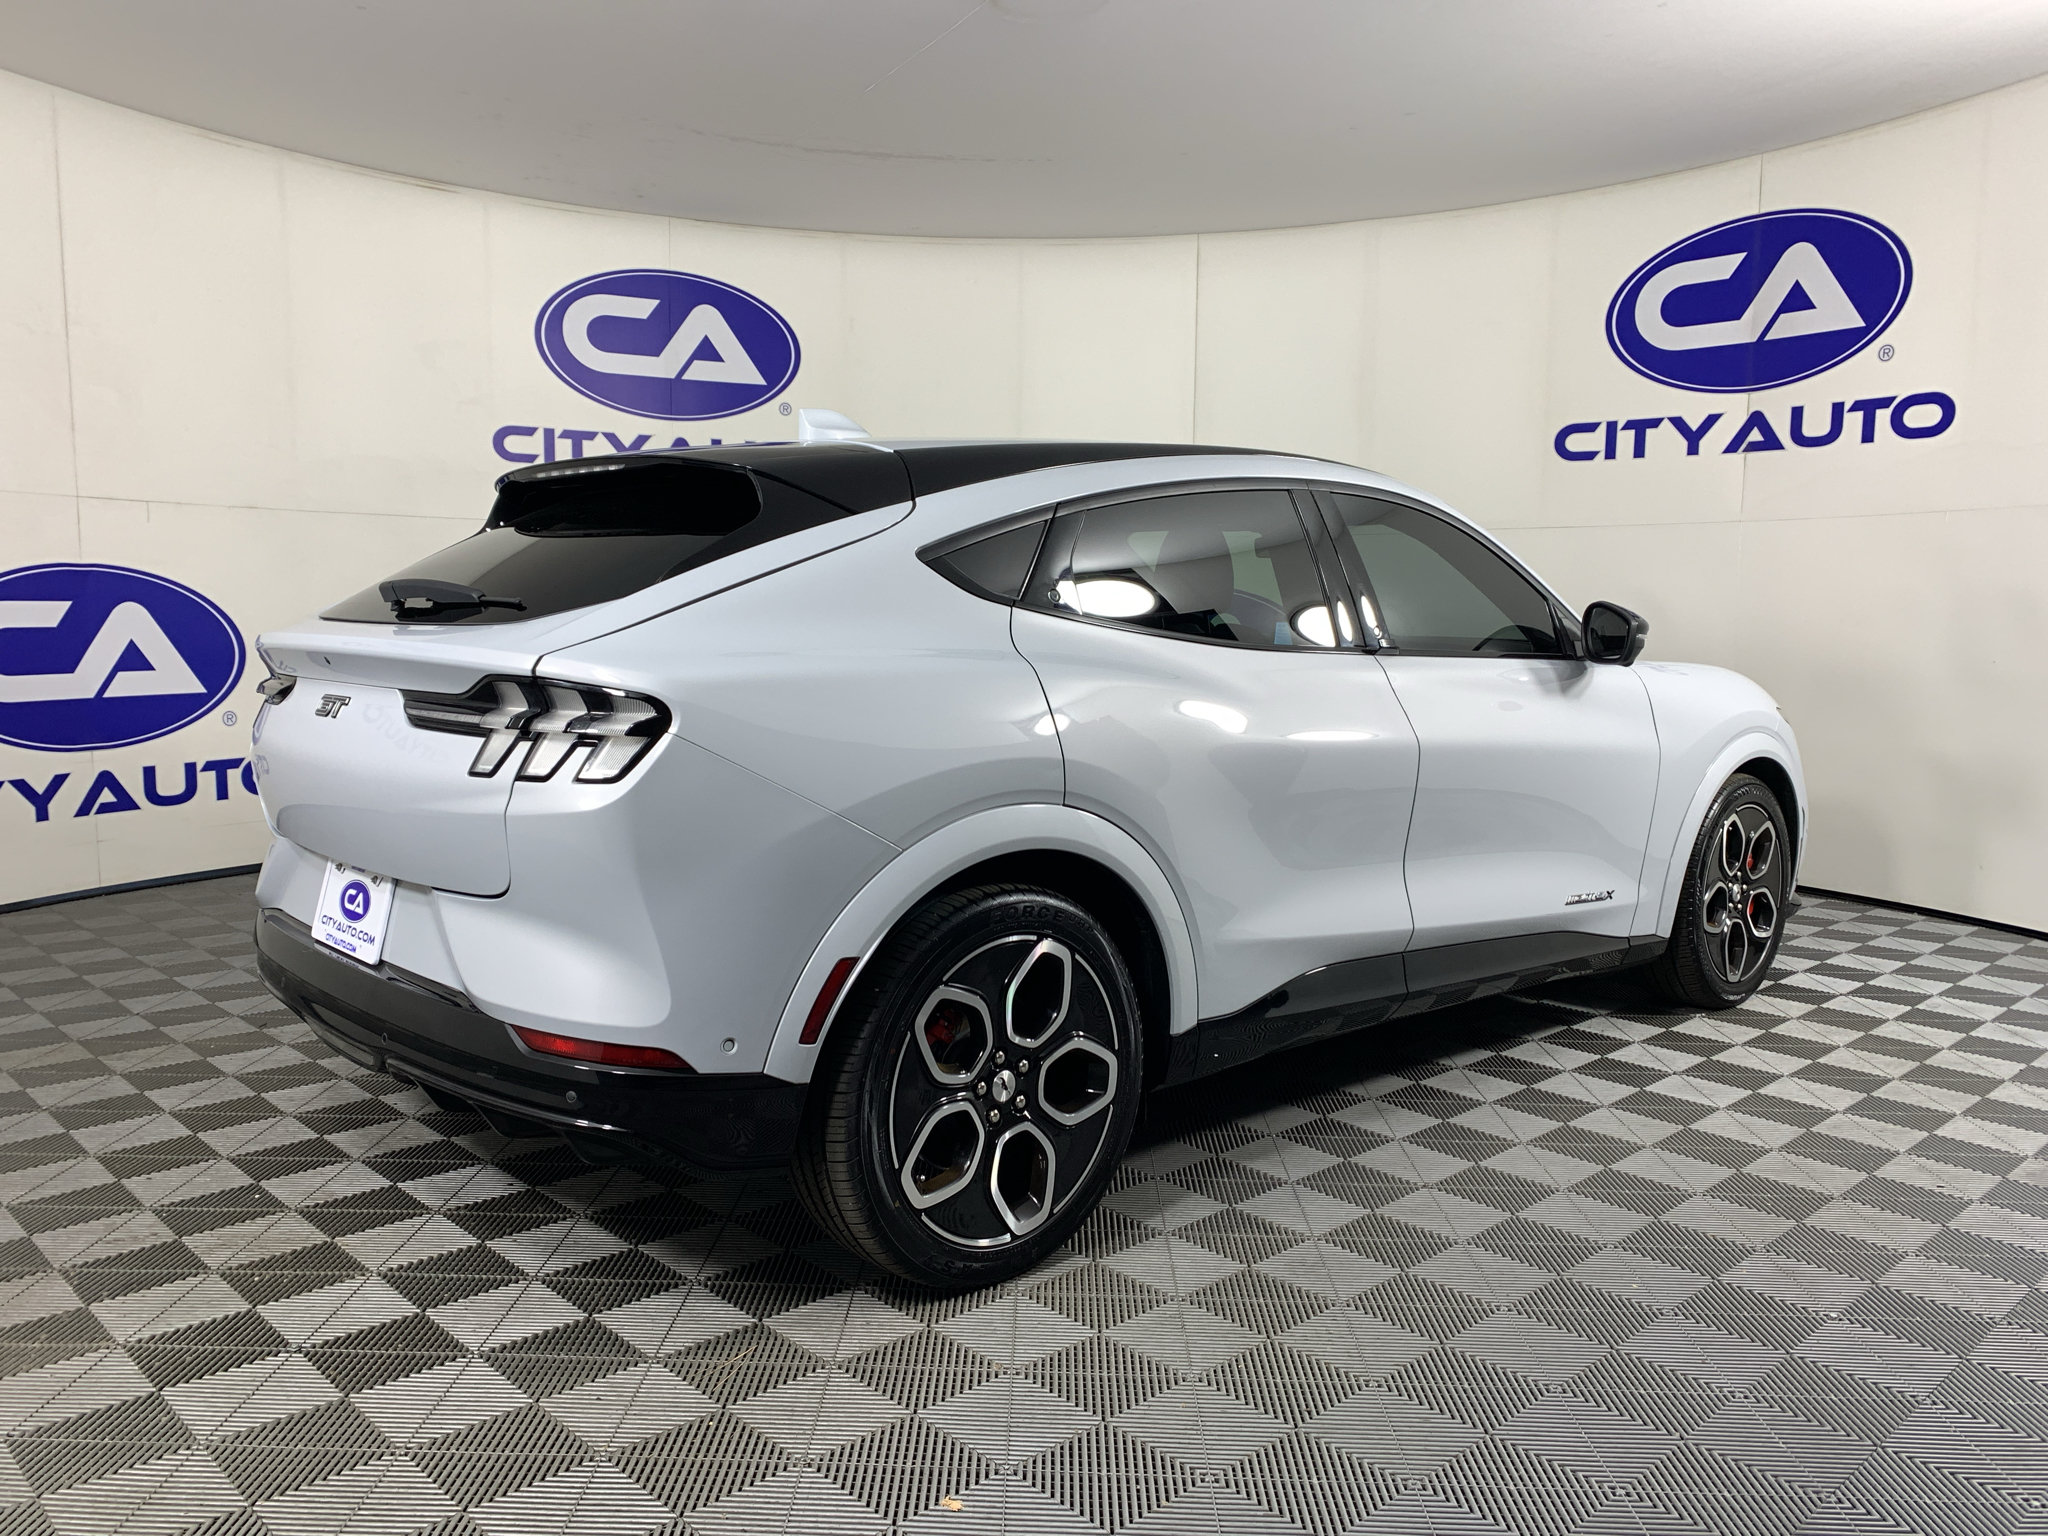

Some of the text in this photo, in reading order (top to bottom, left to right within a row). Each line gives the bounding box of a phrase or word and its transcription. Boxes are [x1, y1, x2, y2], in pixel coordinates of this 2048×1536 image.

[1635, 241, 1866, 351] CA
[562, 293, 768, 385] CA
[321, 914, 376, 946] CITYAUTO.COM
[343, 888, 364, 915] CA
